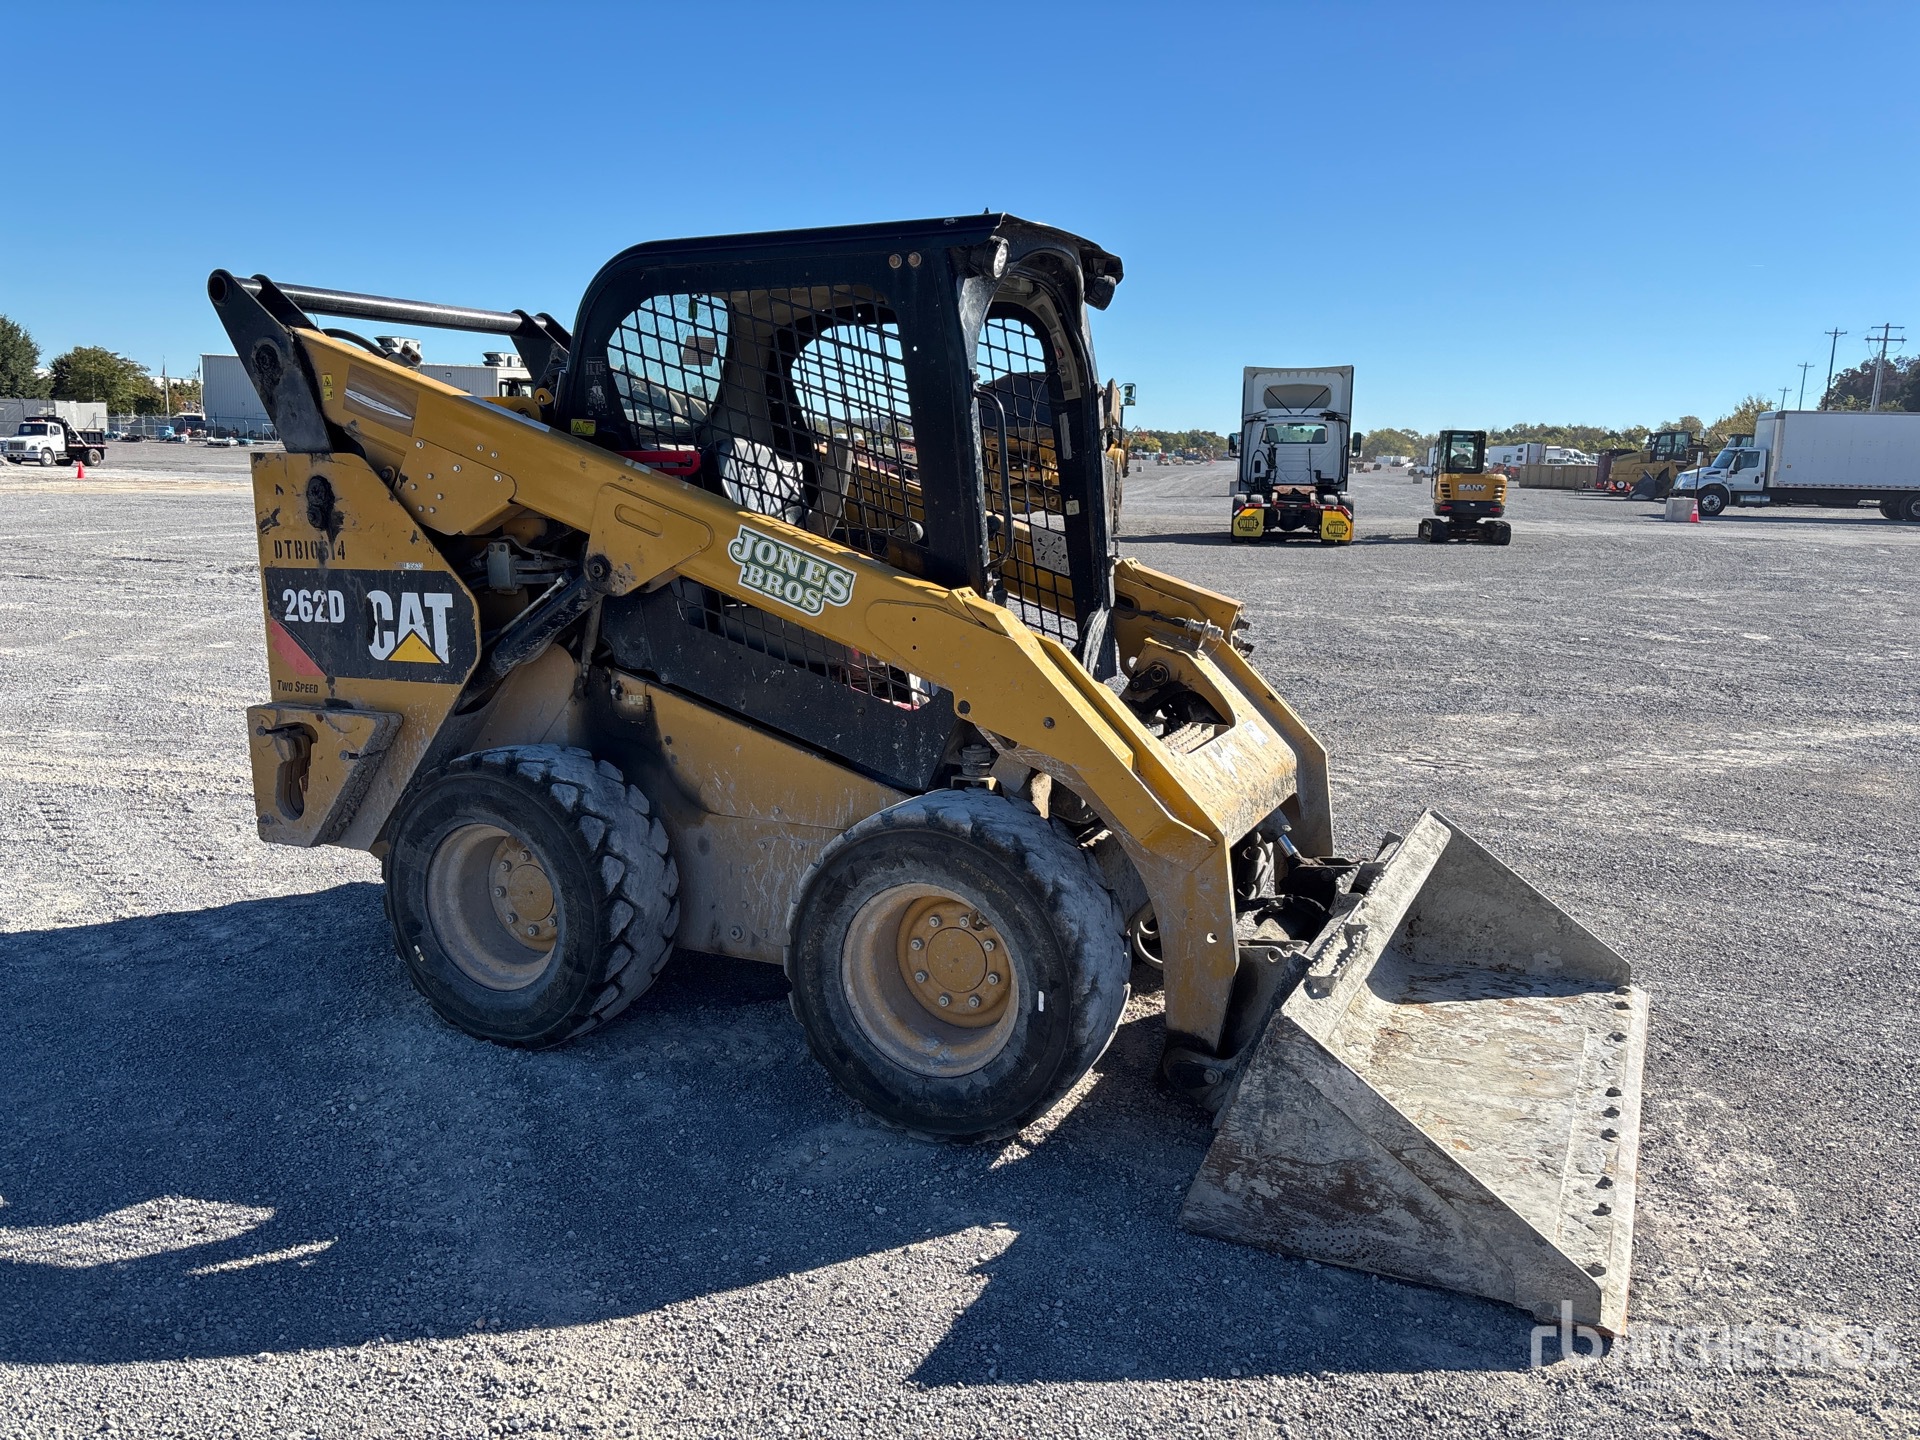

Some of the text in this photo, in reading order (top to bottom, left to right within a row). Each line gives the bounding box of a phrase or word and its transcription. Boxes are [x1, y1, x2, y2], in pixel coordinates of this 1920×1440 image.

[1458, 484, 1487, 492] SANY
[1239, 519, 1257, 528] WIDE
[1328, 525, 1347, 534] WIDE
[730, 530, 851, 602] JONES
[743, 562, 822, 612] BROS
[282, 588, 345, 624] 262D
[366, 590, 454, 664] CAT
